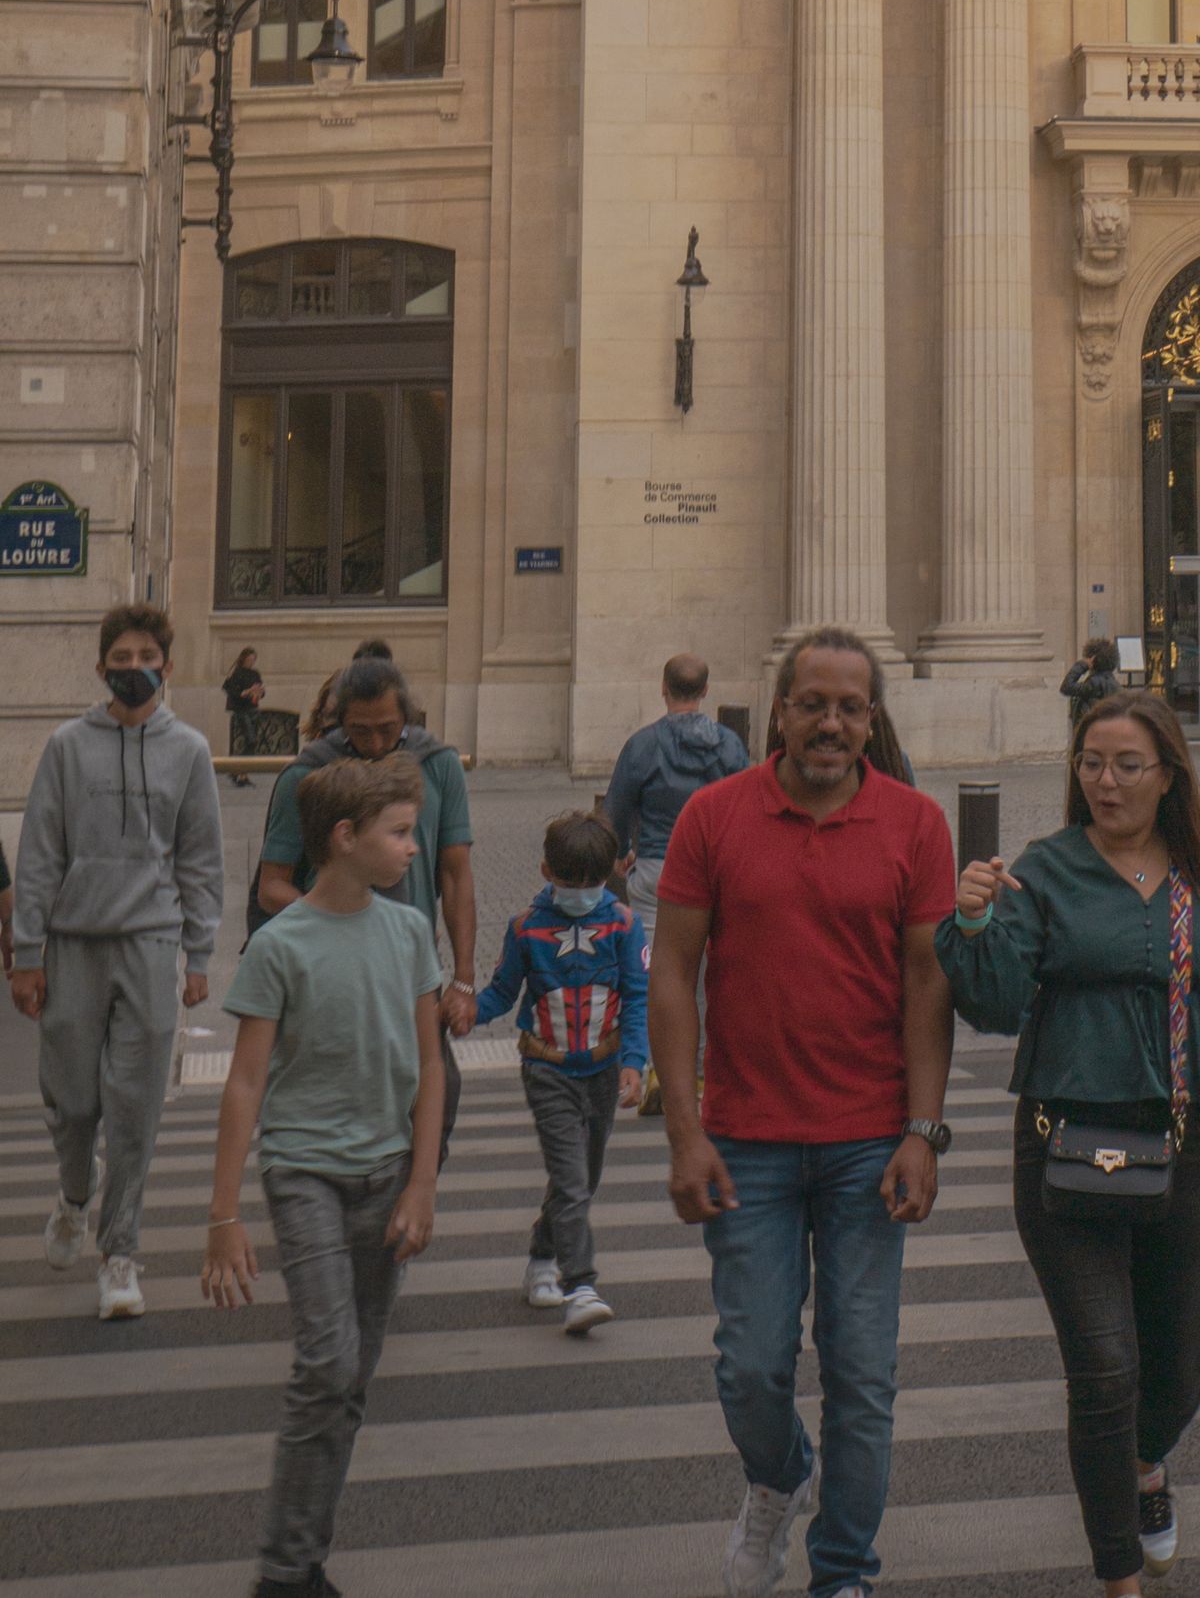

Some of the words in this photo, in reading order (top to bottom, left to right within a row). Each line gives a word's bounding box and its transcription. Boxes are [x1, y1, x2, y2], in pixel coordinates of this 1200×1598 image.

[645, 481, 682, 491] Bourse
[644, 493, 657, 502] de
[660, 492, 717, 502] Commerce
[678, 503, 717, 513] Pinault
[644, 514, 699, 524] Collection
[19, 521, 56, 537] RUE
[30, 538, 44, 547] DU
[2, 549, 71, 565] LOUVRE
